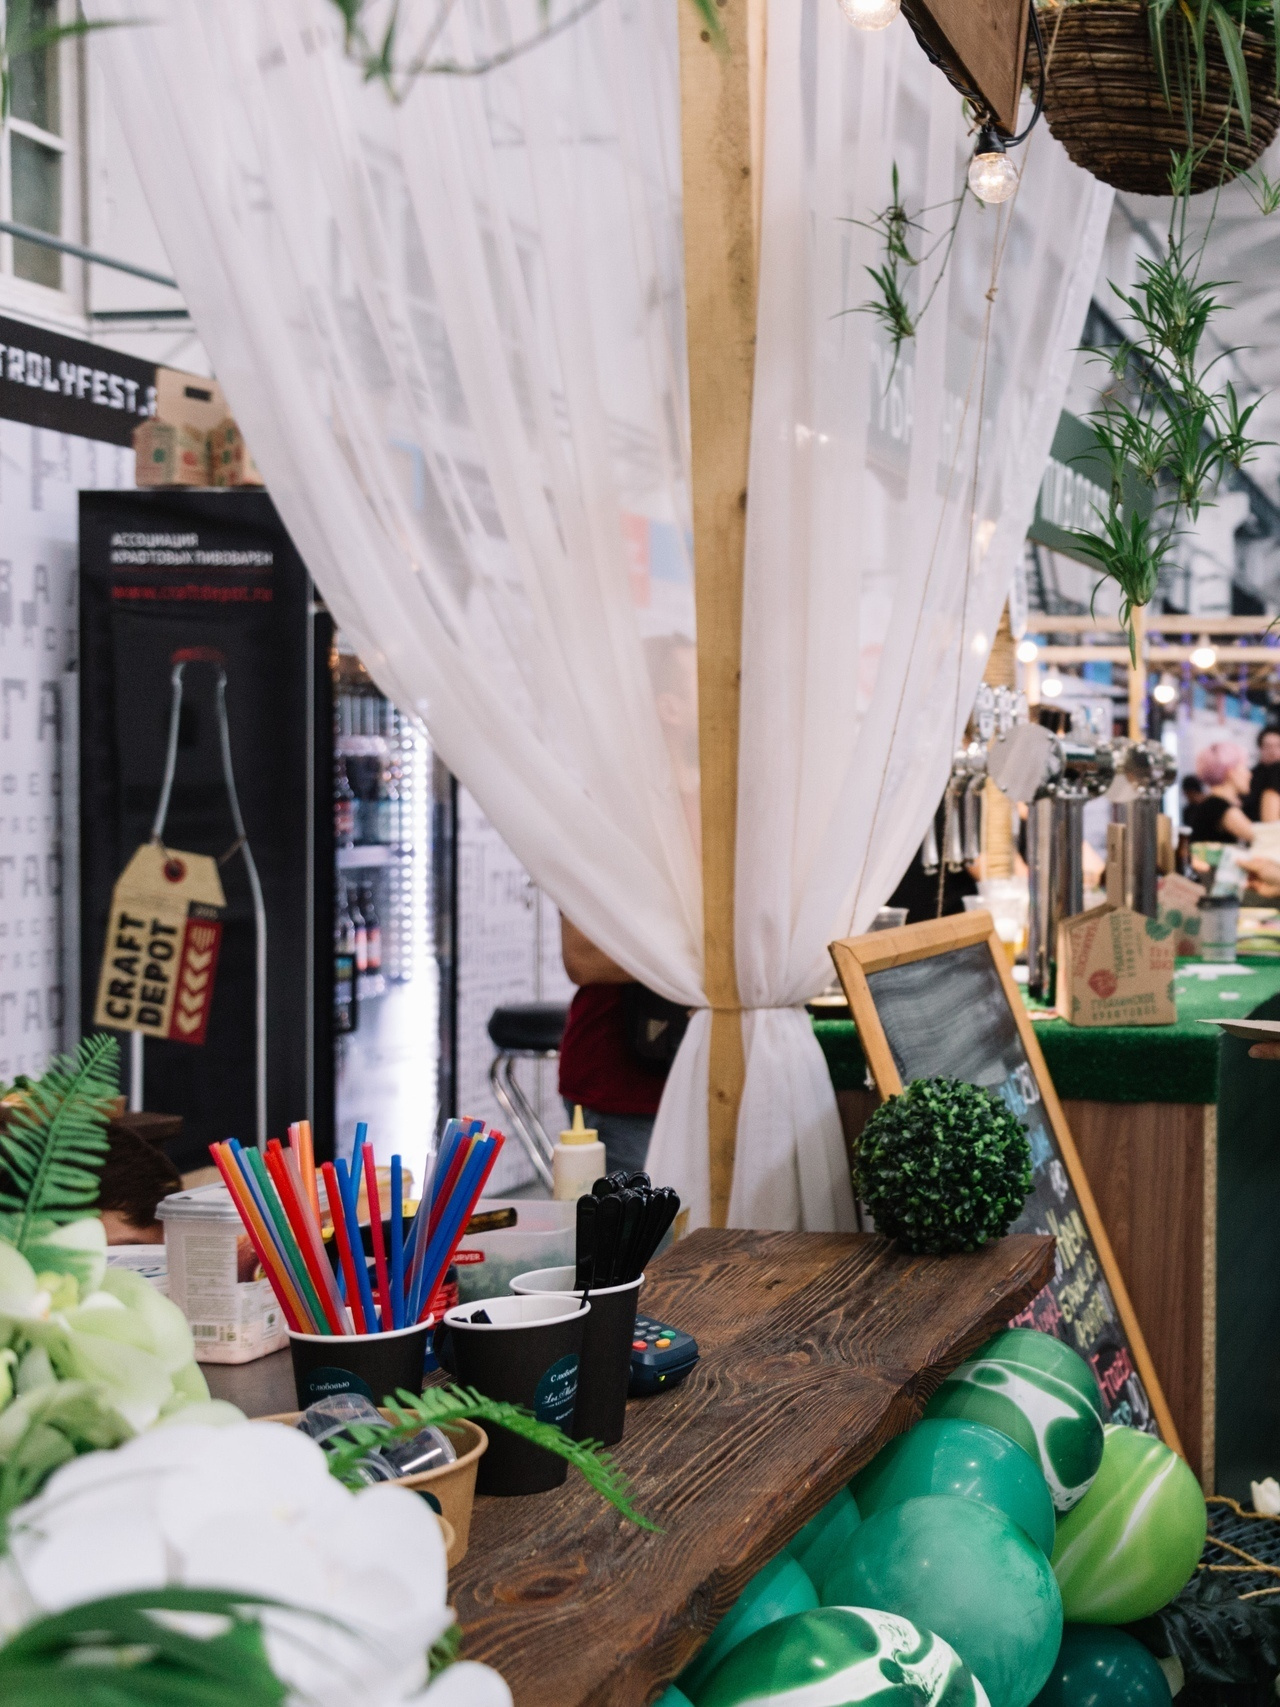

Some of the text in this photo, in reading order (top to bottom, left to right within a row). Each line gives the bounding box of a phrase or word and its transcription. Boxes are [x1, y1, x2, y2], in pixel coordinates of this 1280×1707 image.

[106, 911, 146, 1020] CRAFT
[137, 917, 179, 1027] DEPOT
[454, 1253, 481, 1261] URVER
